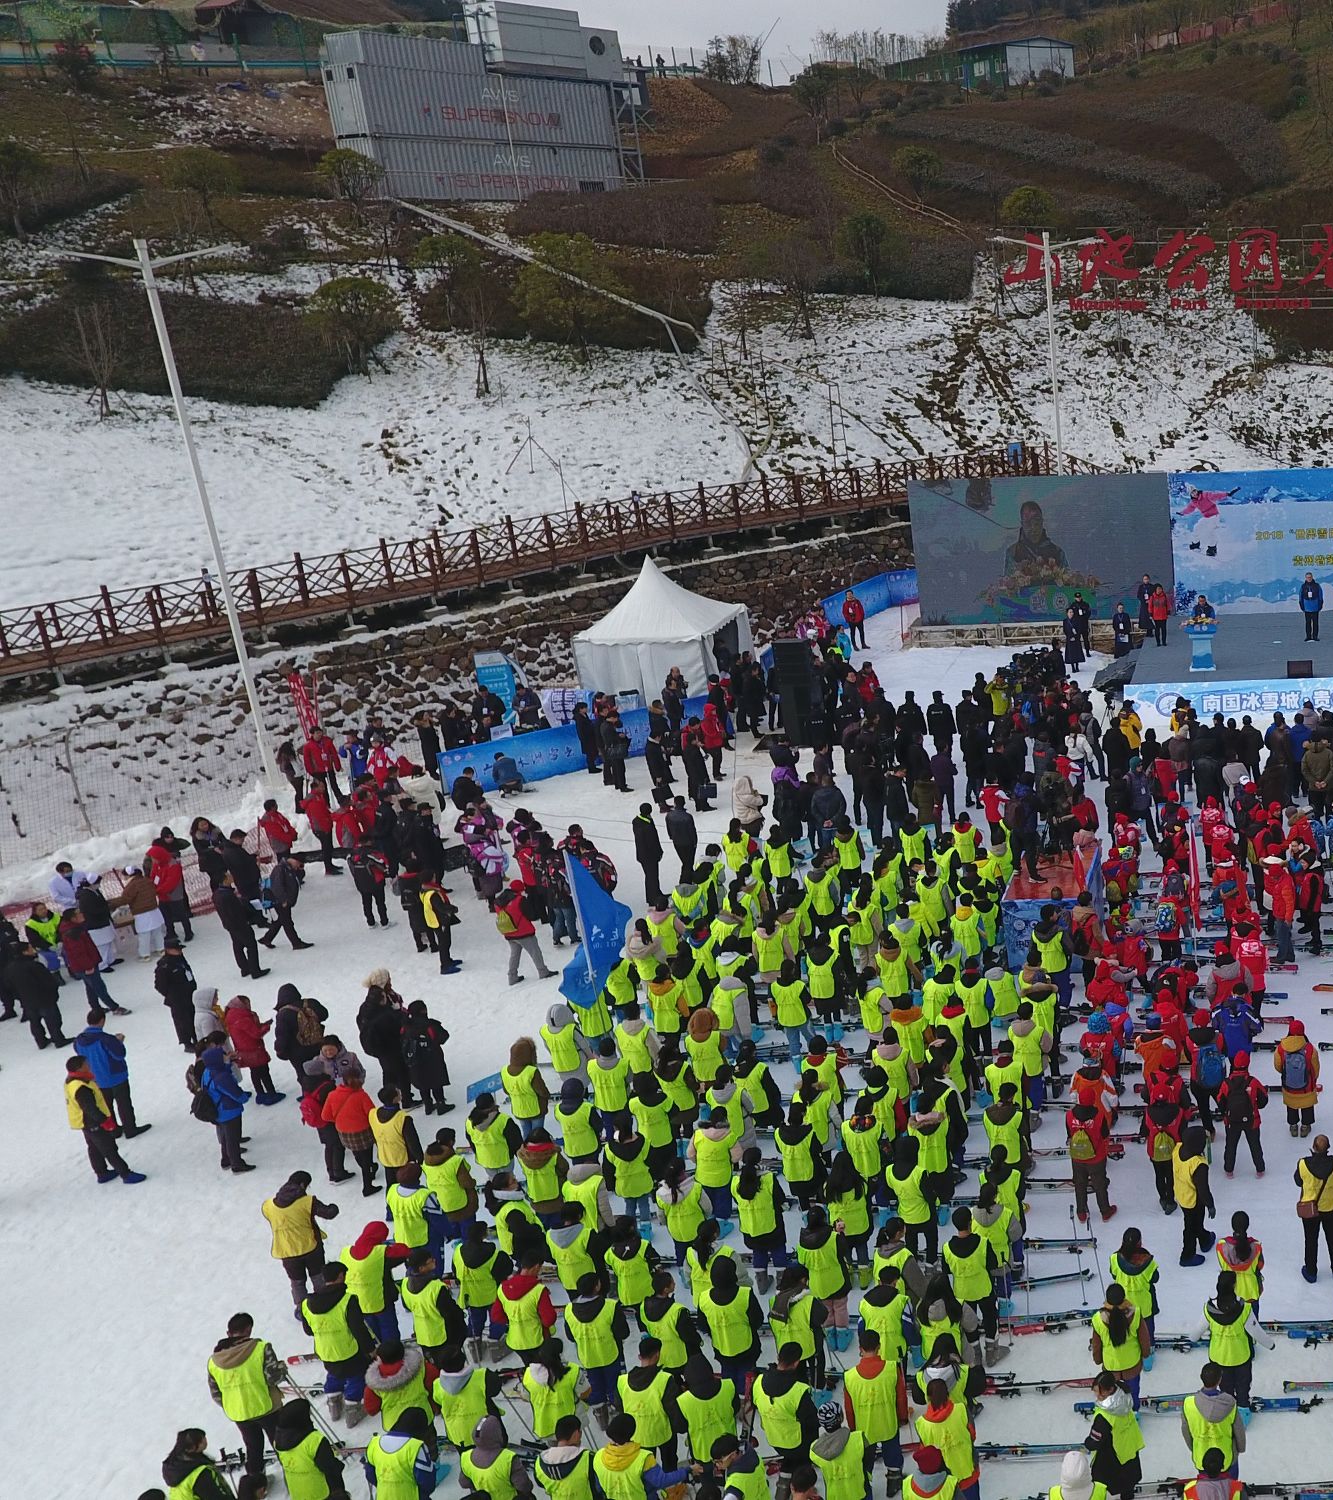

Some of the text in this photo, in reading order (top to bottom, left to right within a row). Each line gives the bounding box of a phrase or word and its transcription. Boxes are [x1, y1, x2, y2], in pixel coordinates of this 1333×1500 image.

[481, 87, 519, 101] AWS
[493, 154, 531, 167] AWS
[1170, 297, 1209, 310] Park
